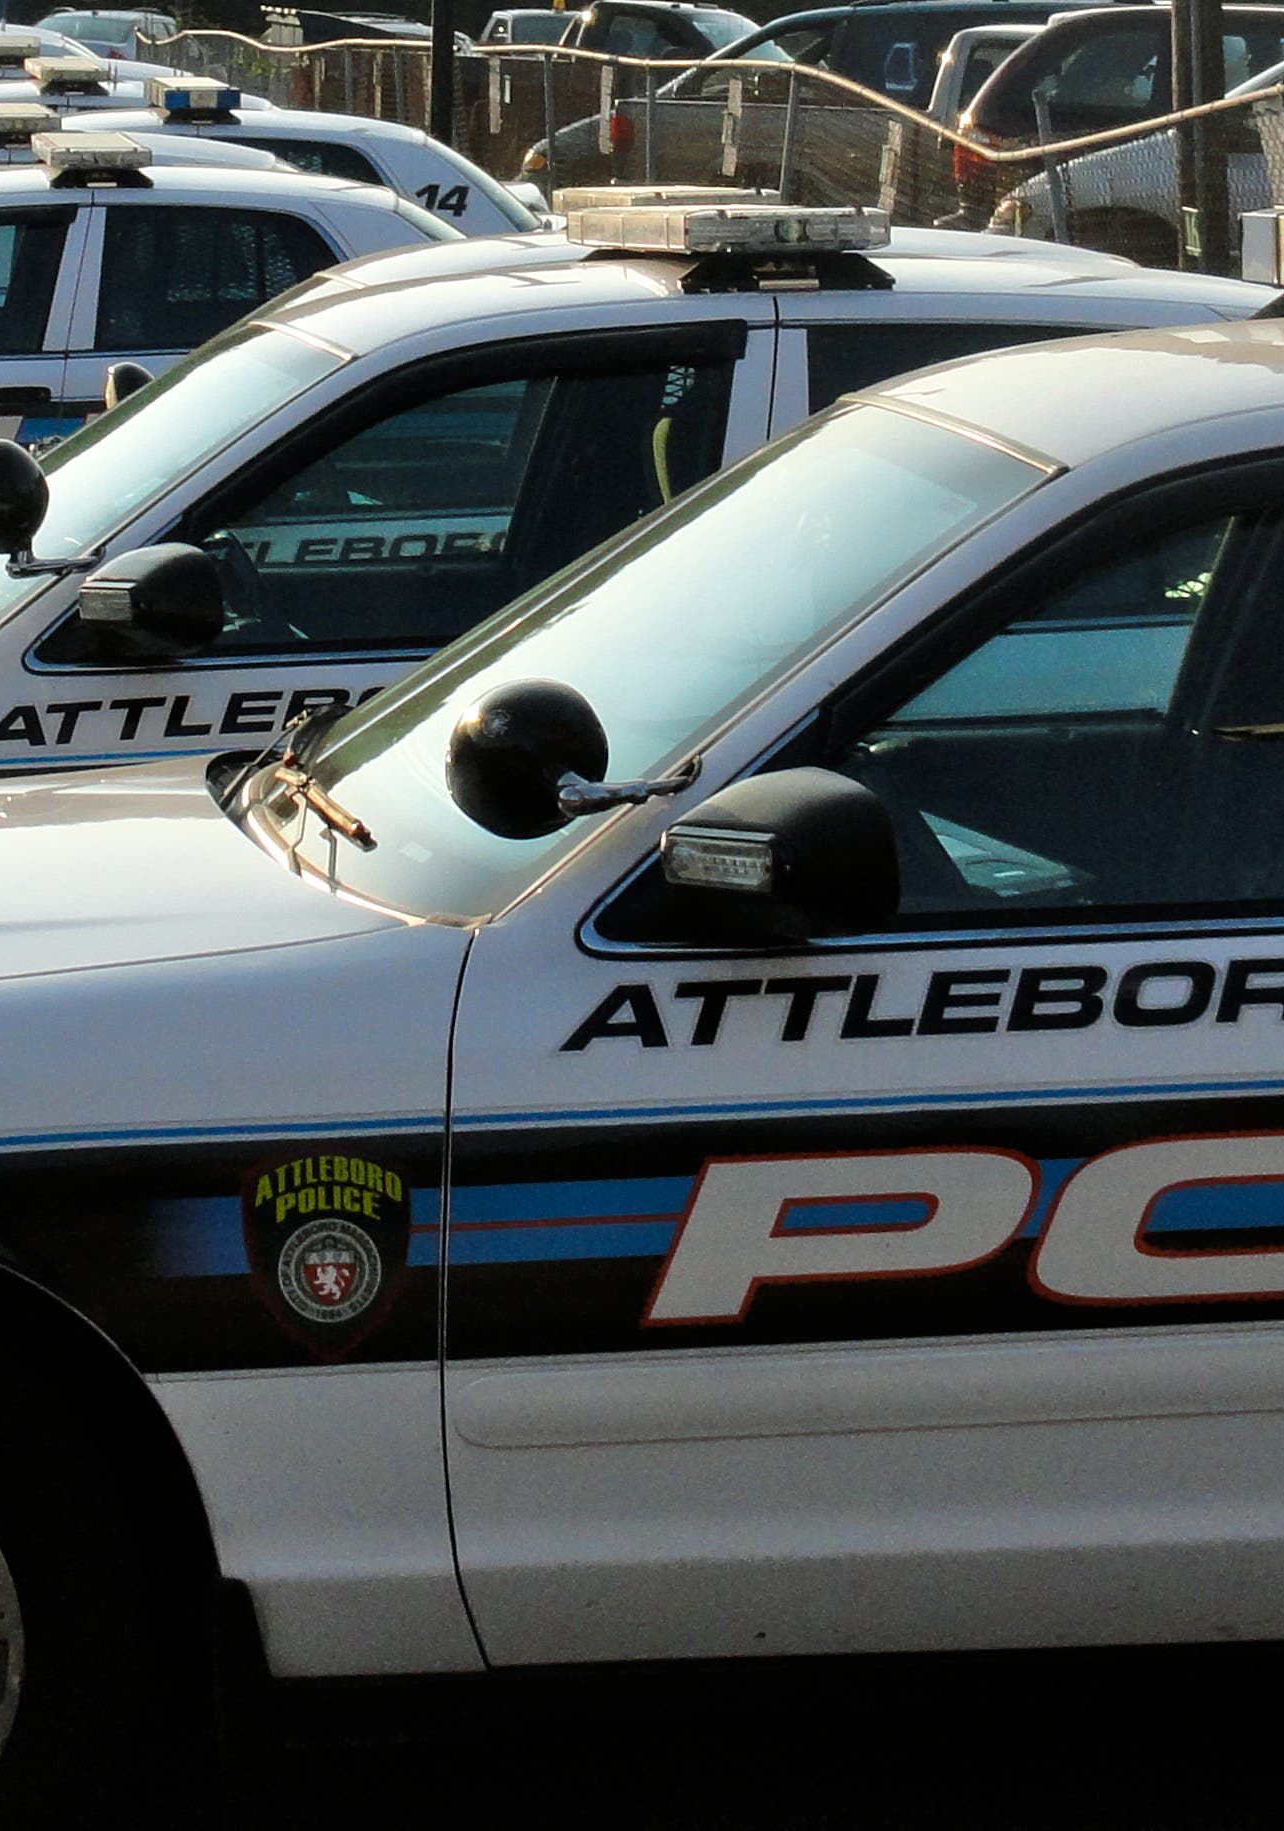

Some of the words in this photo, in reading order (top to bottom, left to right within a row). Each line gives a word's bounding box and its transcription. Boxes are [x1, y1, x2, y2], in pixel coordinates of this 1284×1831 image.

[414, 184, 470, 217] 14
[255, 1155, 403, 1208] ATTLEBORO
[275, 1185, 381, 1224] POLICE
